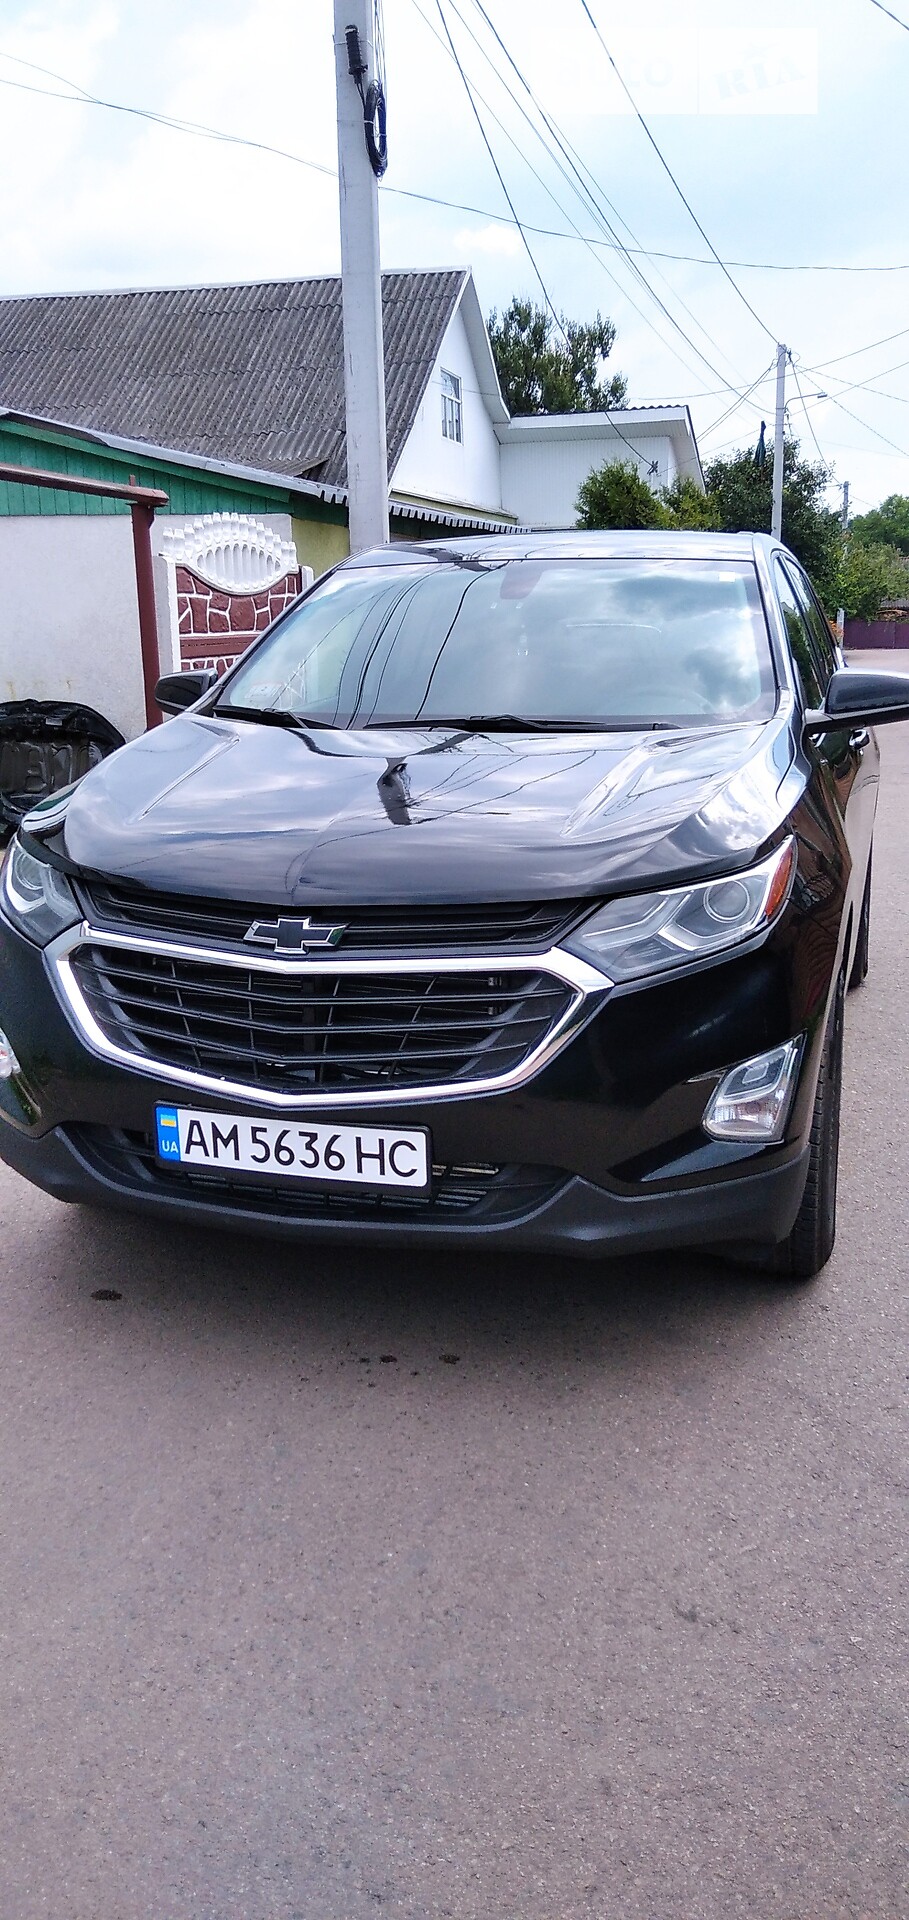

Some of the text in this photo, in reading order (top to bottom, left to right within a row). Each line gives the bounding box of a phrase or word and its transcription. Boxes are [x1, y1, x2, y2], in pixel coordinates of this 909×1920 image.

[161, 1140, 179, 1154] UA
[185, 1119, 418, 1178] AM 5636 HC
